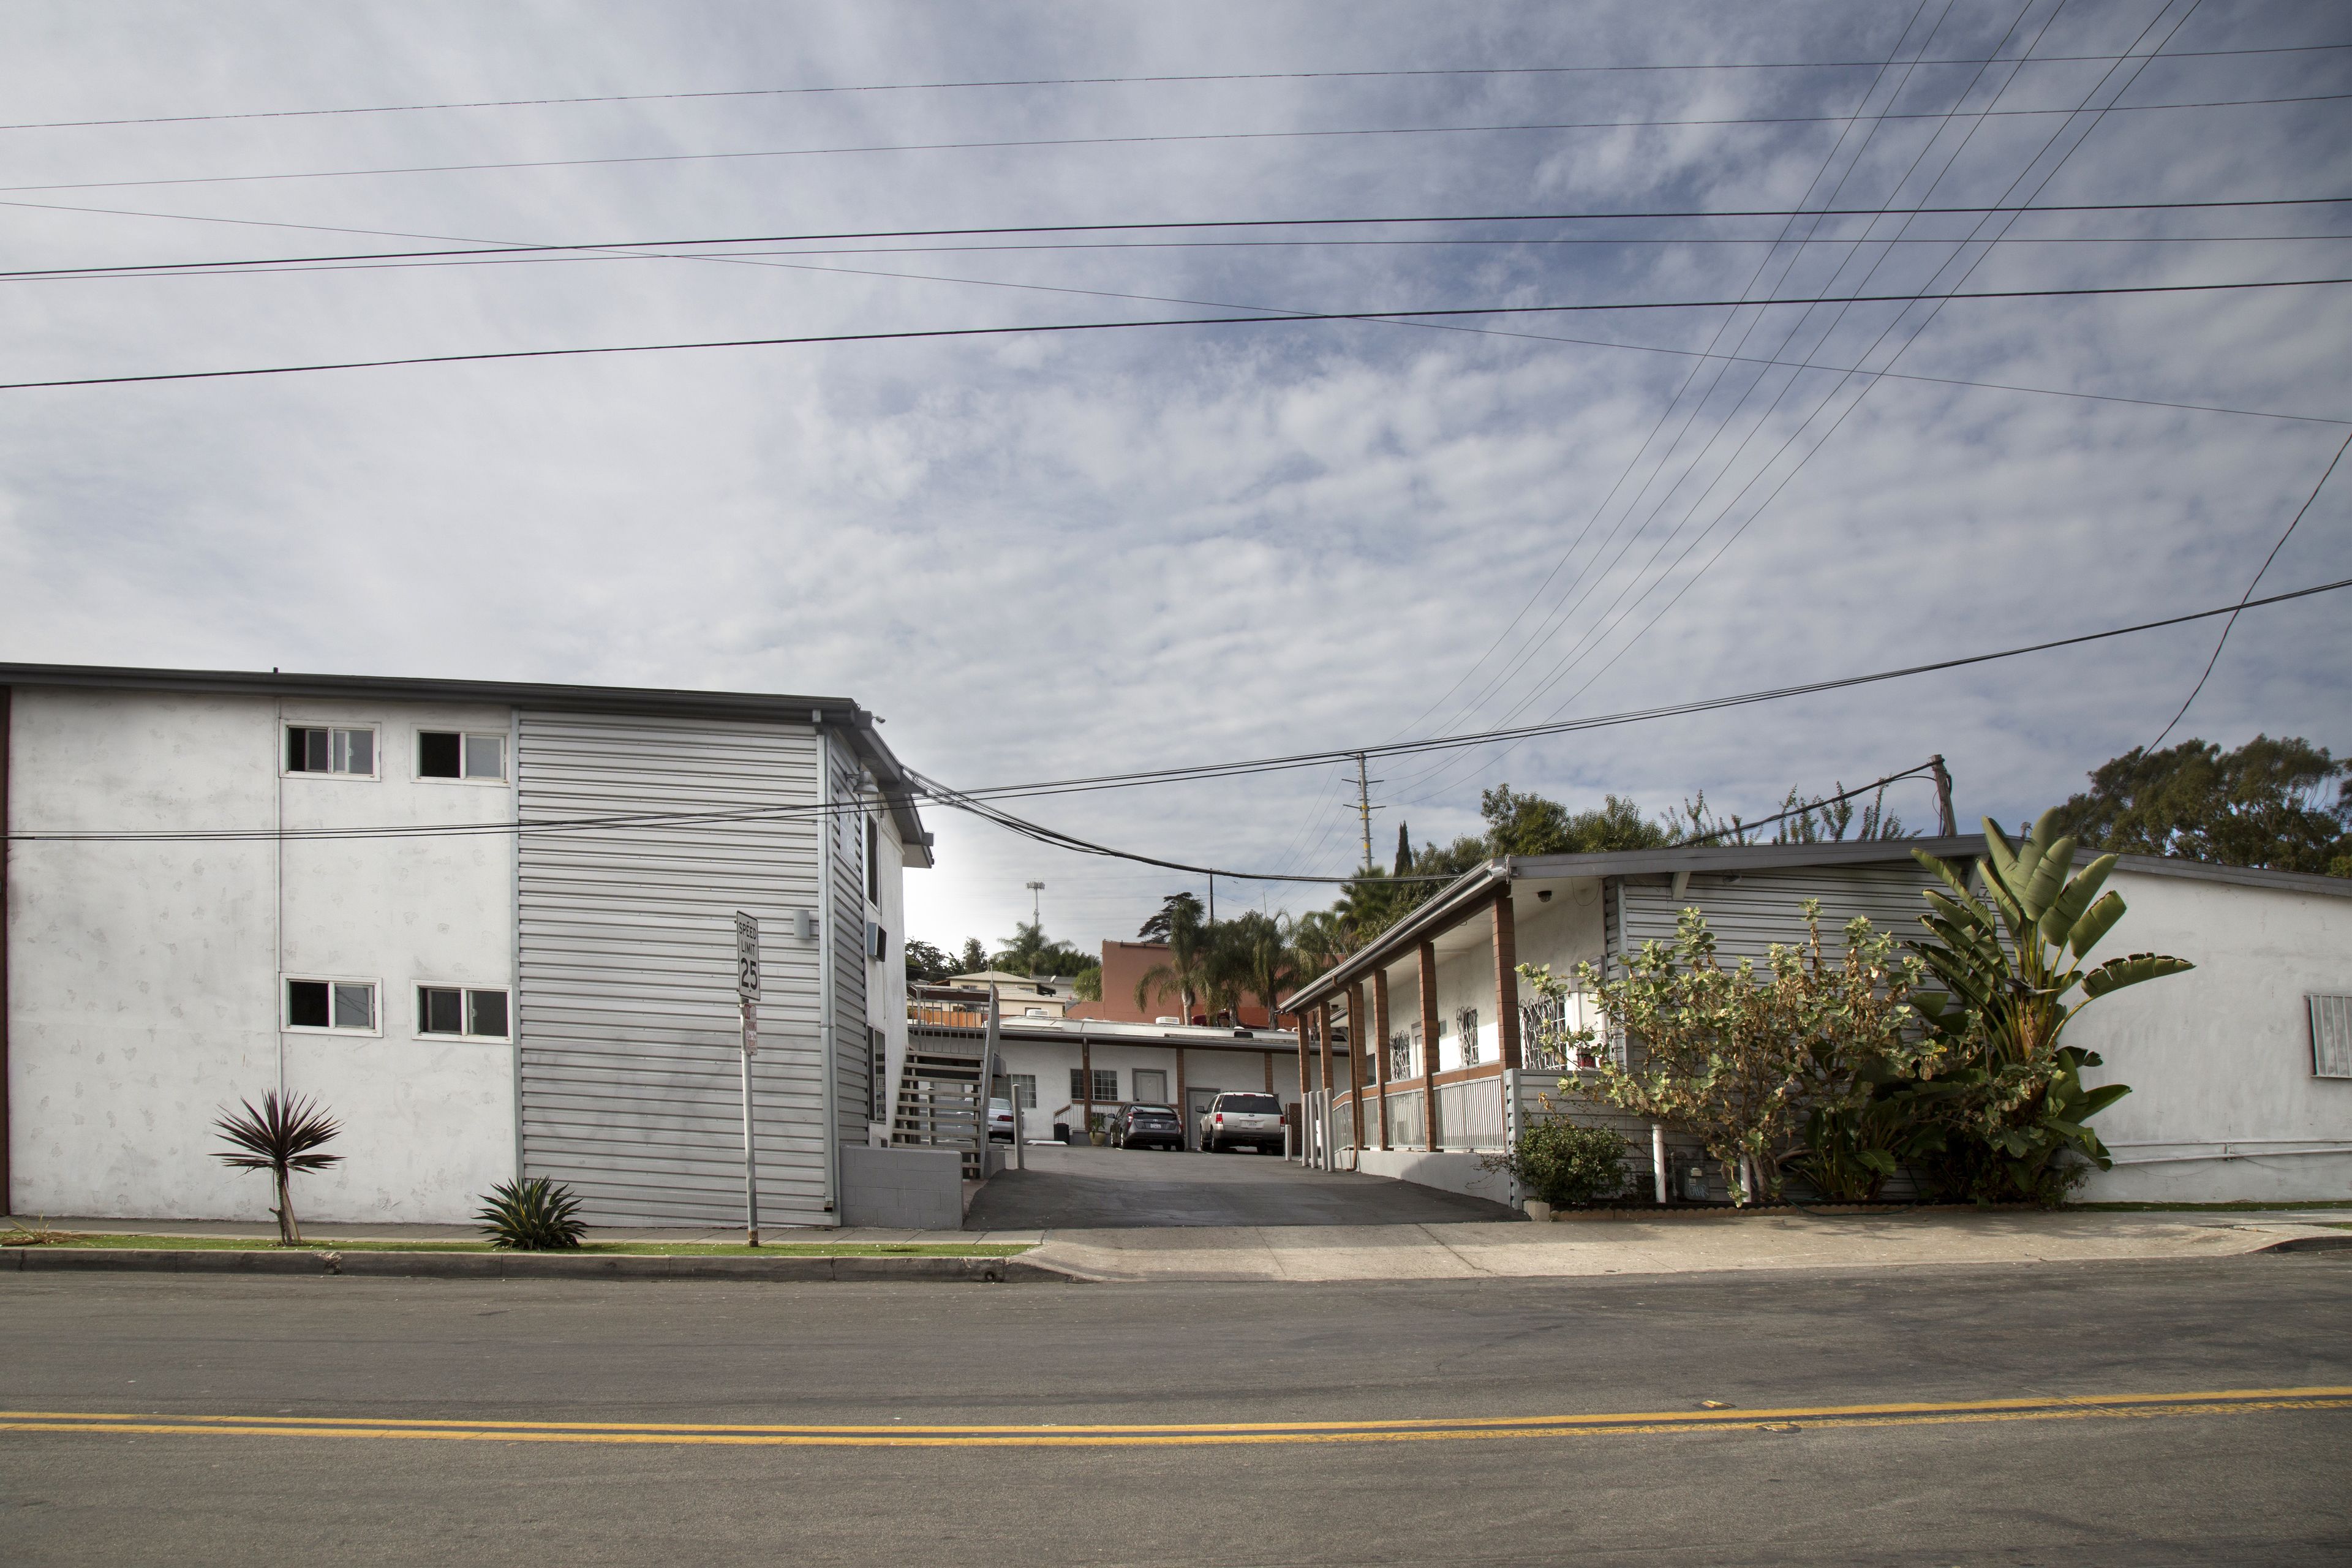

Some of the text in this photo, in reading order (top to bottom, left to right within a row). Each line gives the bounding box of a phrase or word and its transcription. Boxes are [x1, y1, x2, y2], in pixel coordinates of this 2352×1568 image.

[739, 922, 757, 940] SPEED
[741, 939, 756, 956] LIMIT
[741, 957, 758, 990] 25
